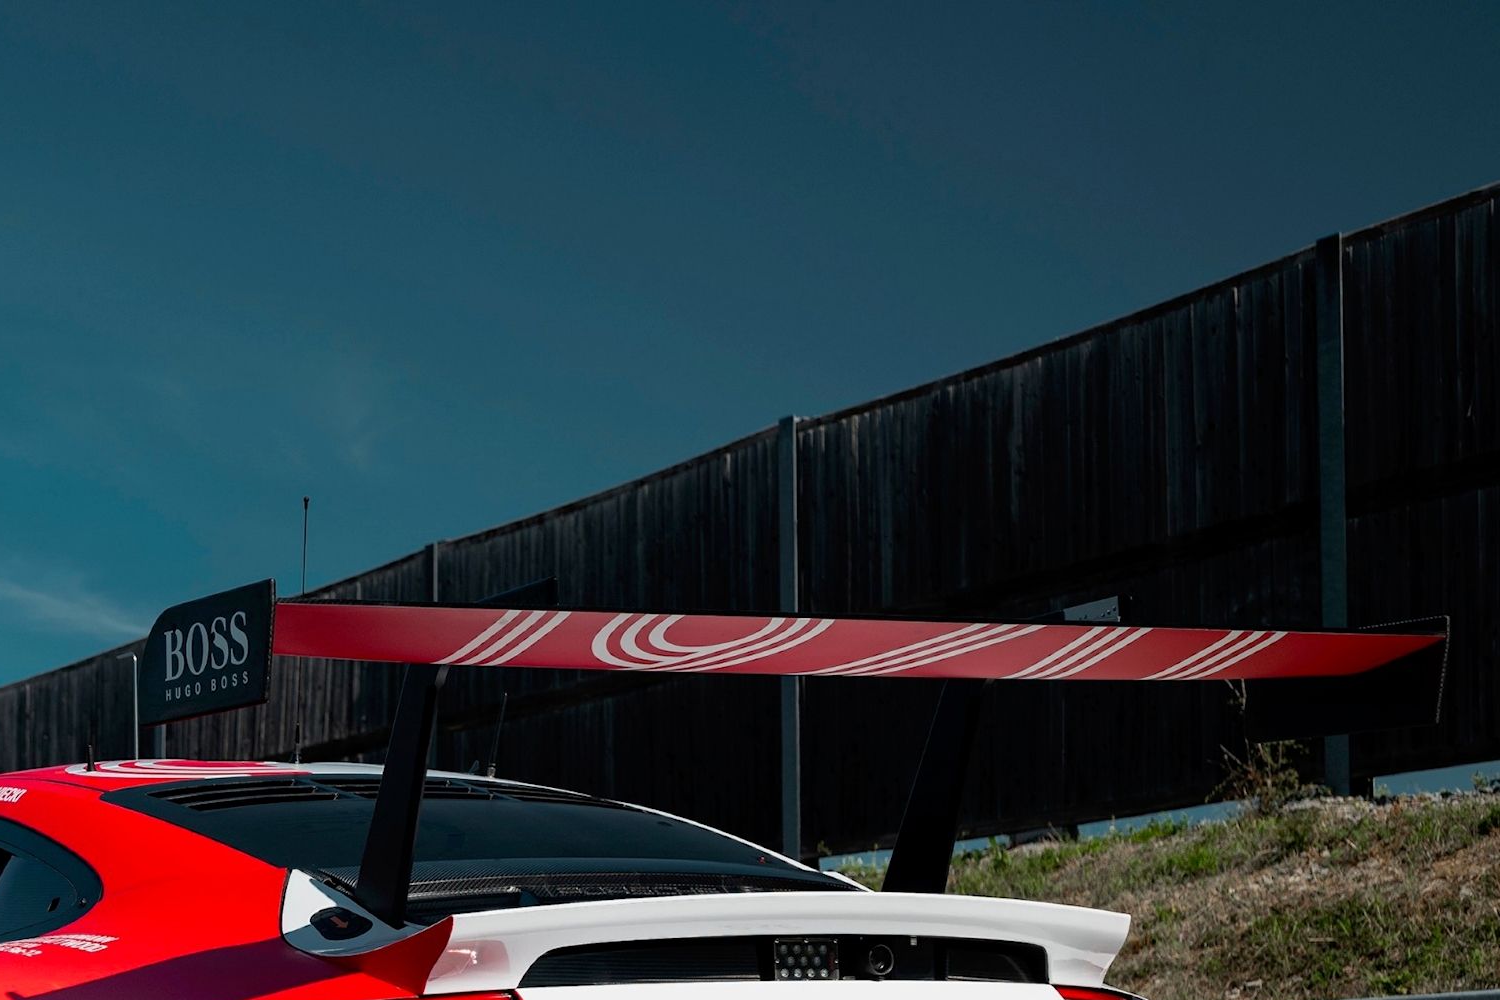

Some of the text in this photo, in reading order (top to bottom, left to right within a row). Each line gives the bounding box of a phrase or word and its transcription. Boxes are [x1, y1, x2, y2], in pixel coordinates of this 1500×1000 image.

[164, 611, 249, 681] BOSS
[166, 671, 249, 701] HUGO BOSS
